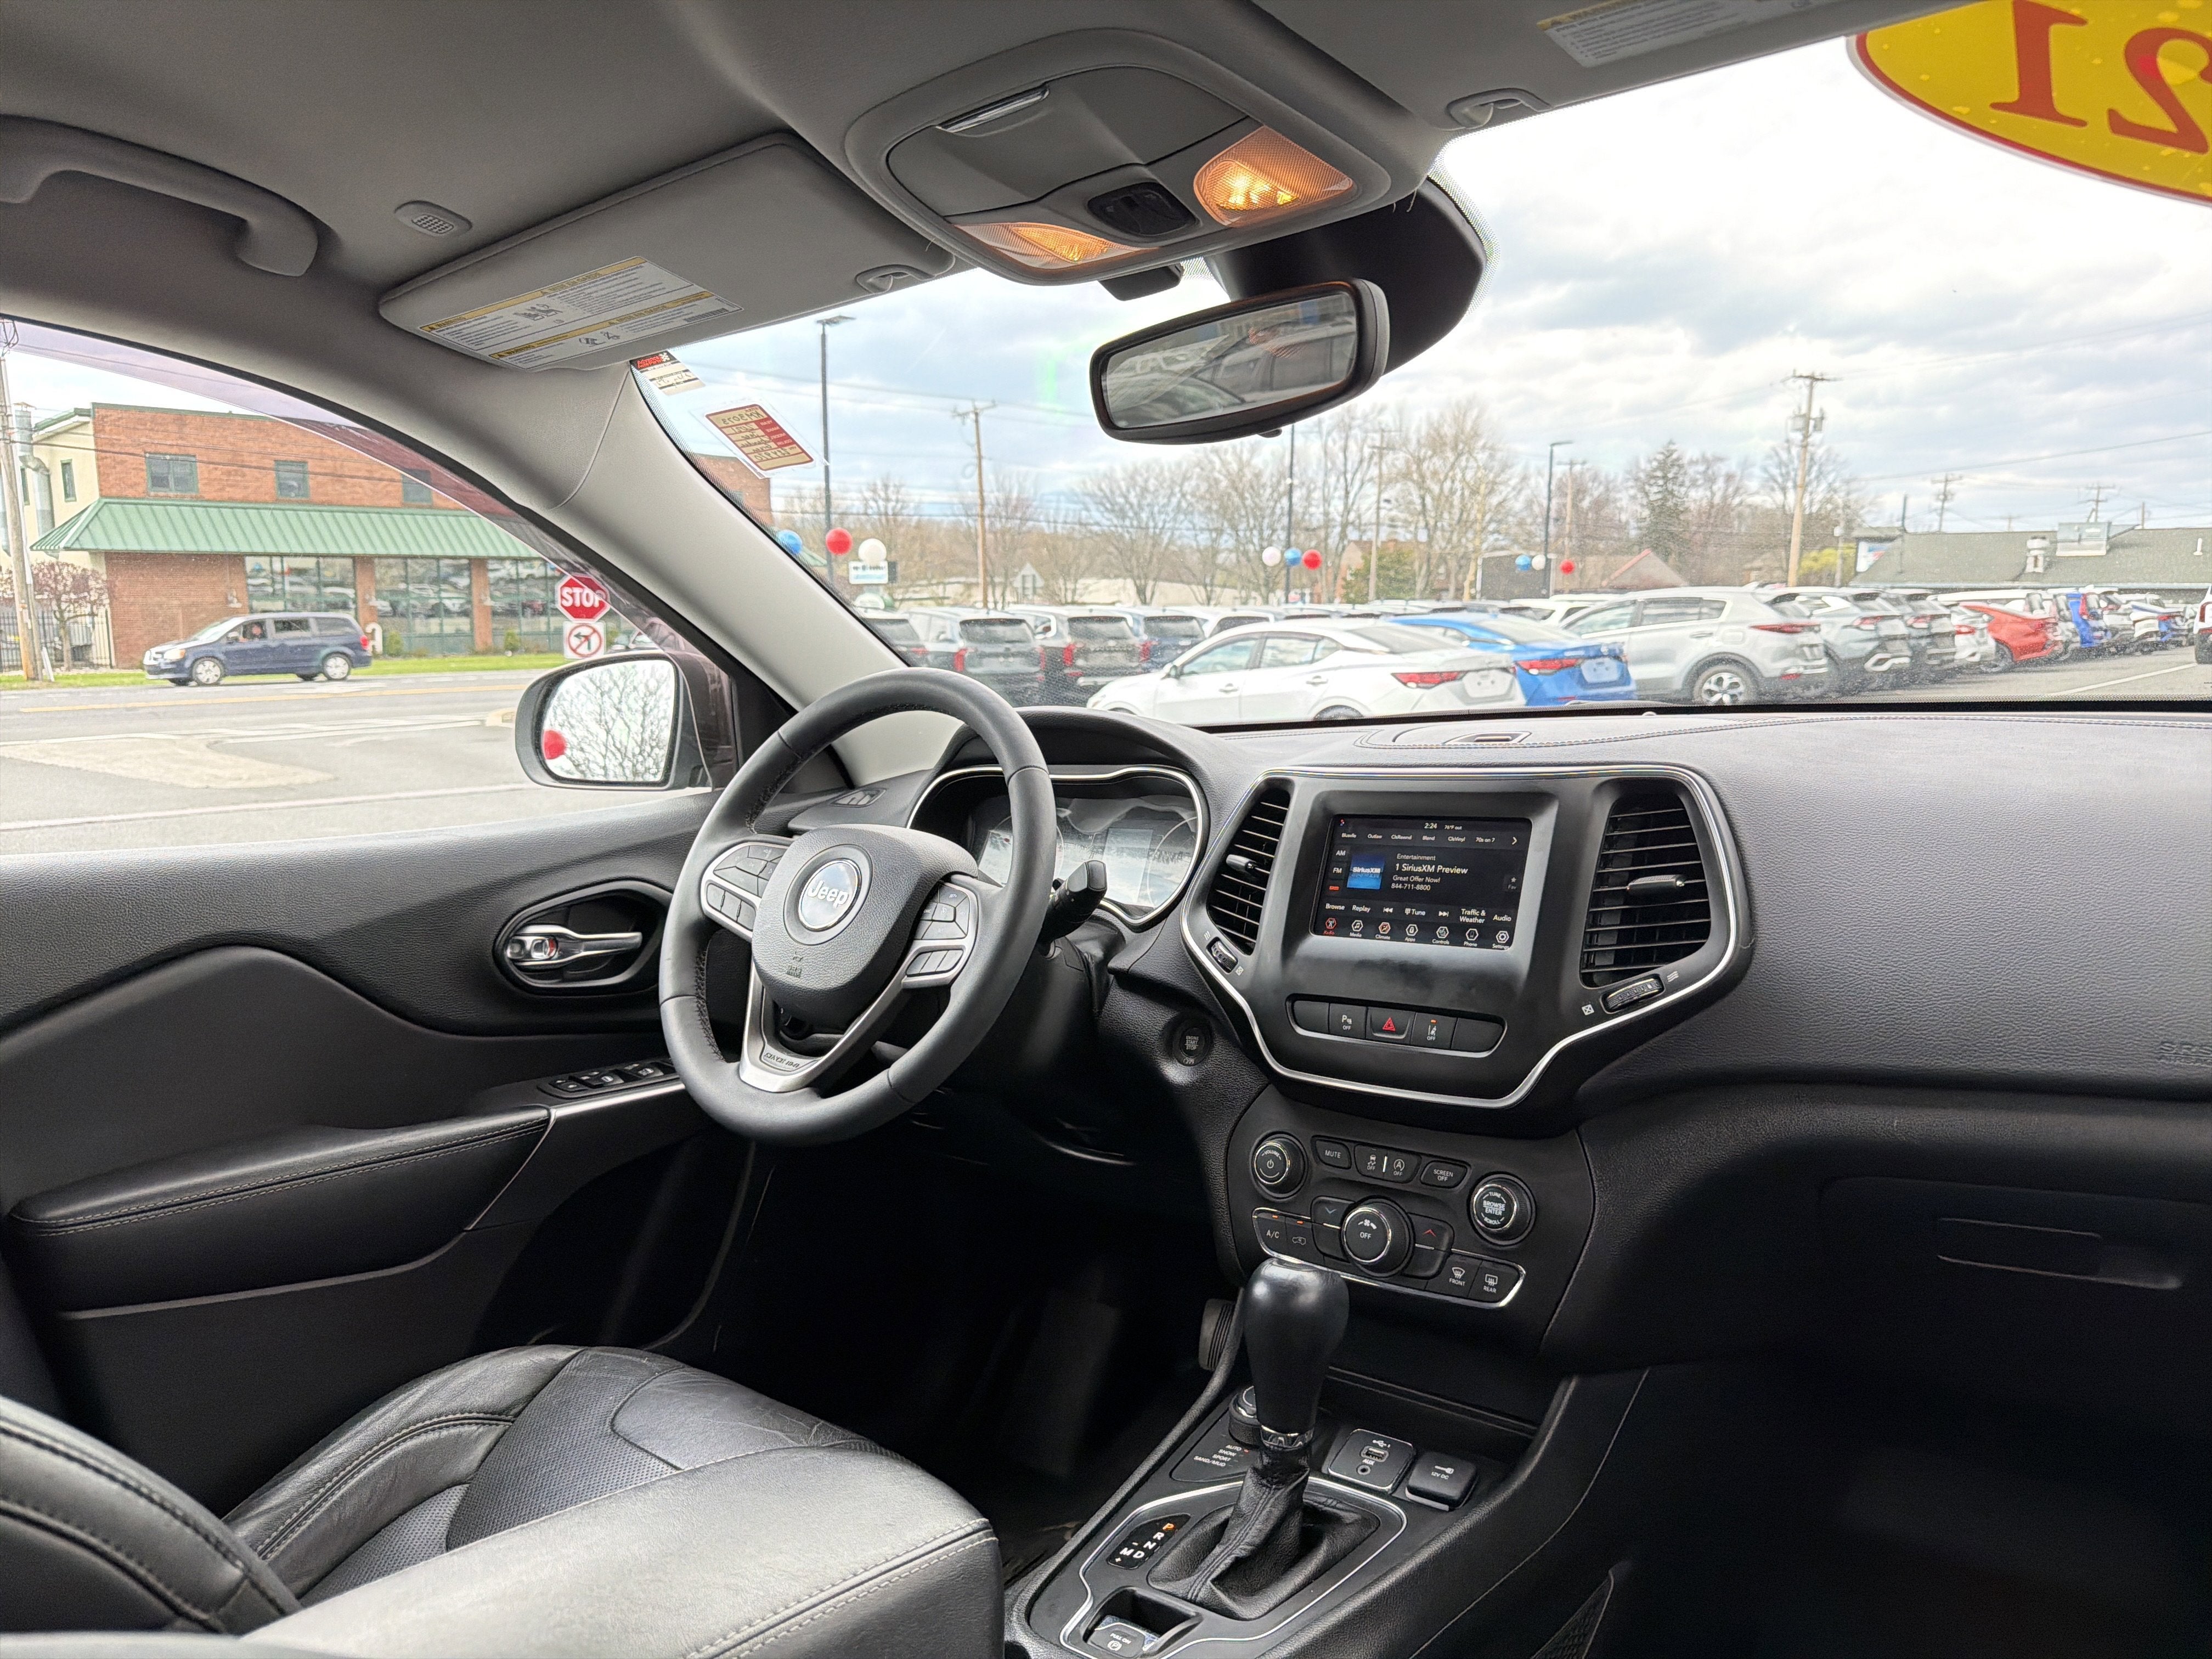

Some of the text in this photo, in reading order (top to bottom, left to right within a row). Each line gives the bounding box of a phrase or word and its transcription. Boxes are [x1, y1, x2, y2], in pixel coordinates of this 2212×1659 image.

[561, 586, 606, 608] STOP
[1402, 863, 1435, 872] SiriusXM
[1437, 865, 1469, 874] Preview
[1391, 883, 1431, 891] 844-711-8800
[808, 880, 849, 908] Jeep
[1459, 916, 1485, 924] Weather
[1264, 1149, 1279, 1158] VOLUME
[1325, 1150, 1341, 1159] MUTE
[1433, 1169, 1453, 1177] SCREEN
[1483, 1200, 1506, 1209] BROWSE
[1485, 1207, 1502, 1216] ENTER
[1483, 1217, 1501, 1225] SCROLL
[1266, 1229, 1279, 1239] A/C
[1359, 1232, 1372, 1240] OFF
[1449, 1278, 1466, 1286] FRONT
[1194, 1455, 1226, 1467] SAND/MUD
[1153, 1532, 1165, 1541] R
[1143, 1541, 1156, 1549] N
[1119, 1547, 1135, 1556] M
